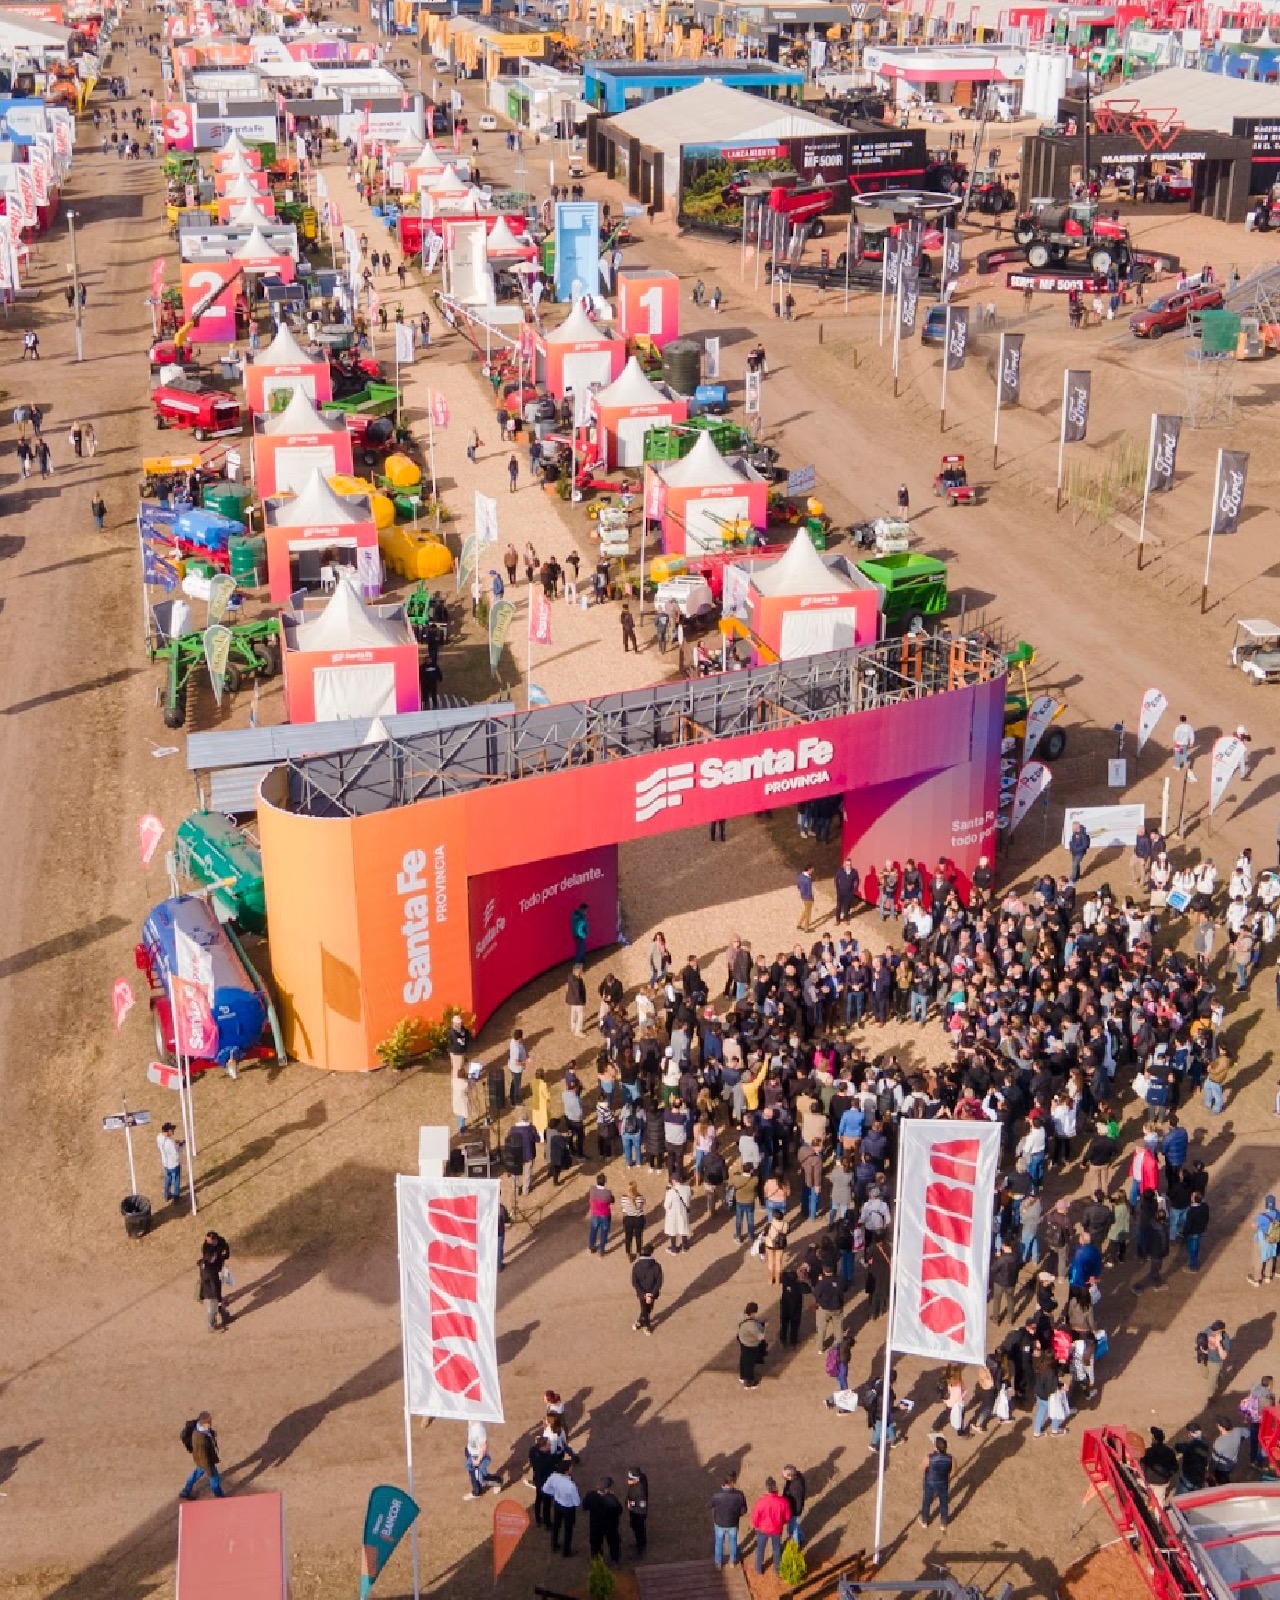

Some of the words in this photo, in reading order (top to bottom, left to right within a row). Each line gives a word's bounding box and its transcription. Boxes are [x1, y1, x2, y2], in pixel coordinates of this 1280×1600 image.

[166, 109, 189, 139] 3
[189, 271, 226, 317] 2
[639, 286, 663, 335] 1
[901, 289, 916, 327] Ford
[949, 319, 967, 358] Ford
[1003, 348, 1021, 388] Ford
[1068, 386, 1087, 425] Ford
[1154, 433, 1177, 477] Ford
[1220, 470, 1244, 518] Ford
[699, 748, 795, 790] Santa
[797, 737, 834, 770] Fe
[764, 770, 831, 796] PROVINCIA
[951, 817, 984, 832] Santa
[951, 834, 978, 847] todo
[396, 848, 428, 894] Fe
[436, 844, 447, 922] PROVINCIA
[519, 892, 541, 913] Todo
[542, 884, 558, 904] por
[560, 867, 605, 892] delante.
[403, 894, 434, 1005] Santa
